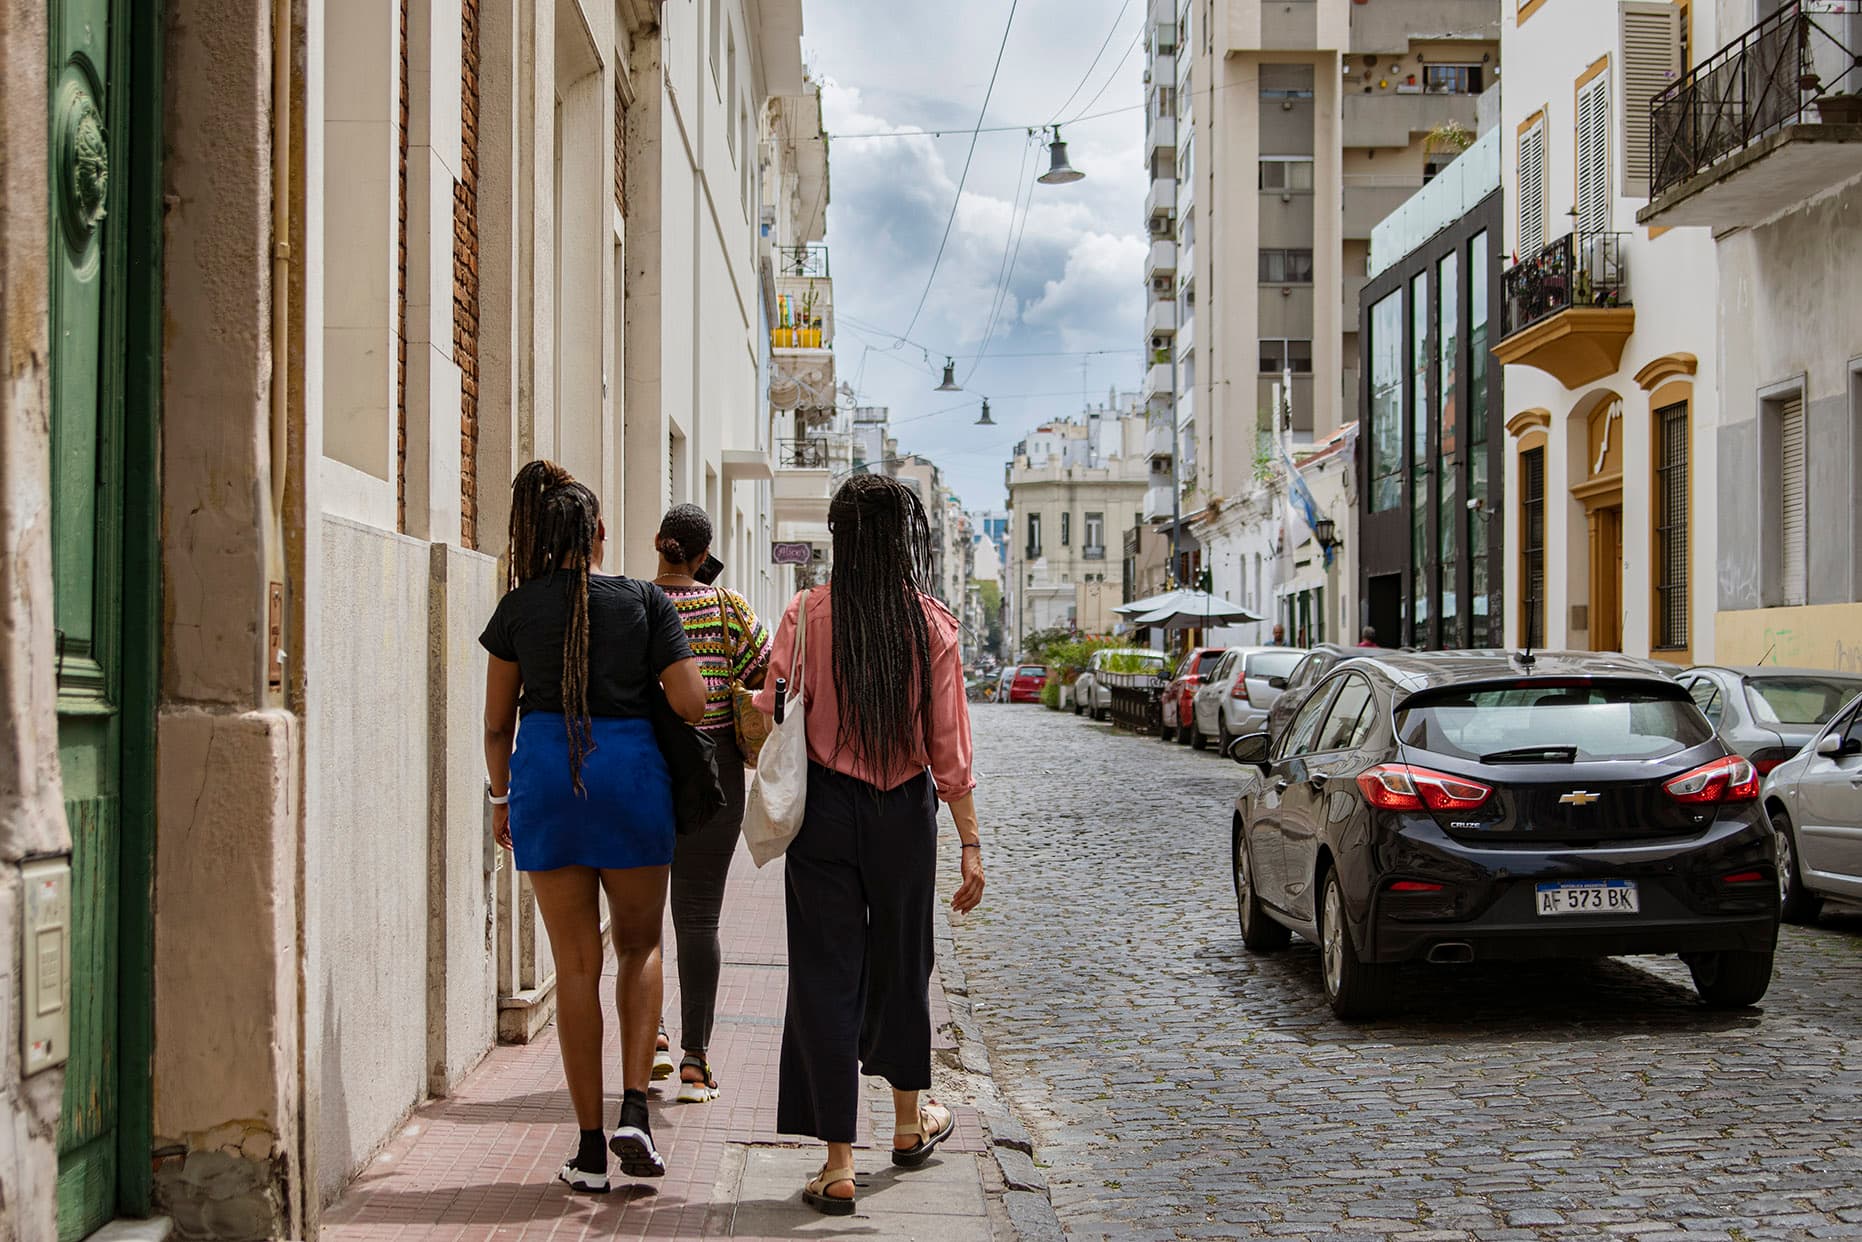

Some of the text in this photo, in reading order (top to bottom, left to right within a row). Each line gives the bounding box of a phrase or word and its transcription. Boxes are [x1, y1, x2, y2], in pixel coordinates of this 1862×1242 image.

[1450, 821, 1480, 829] CRUZE
[1543, 888, 1632, 911] AF 573 BK
